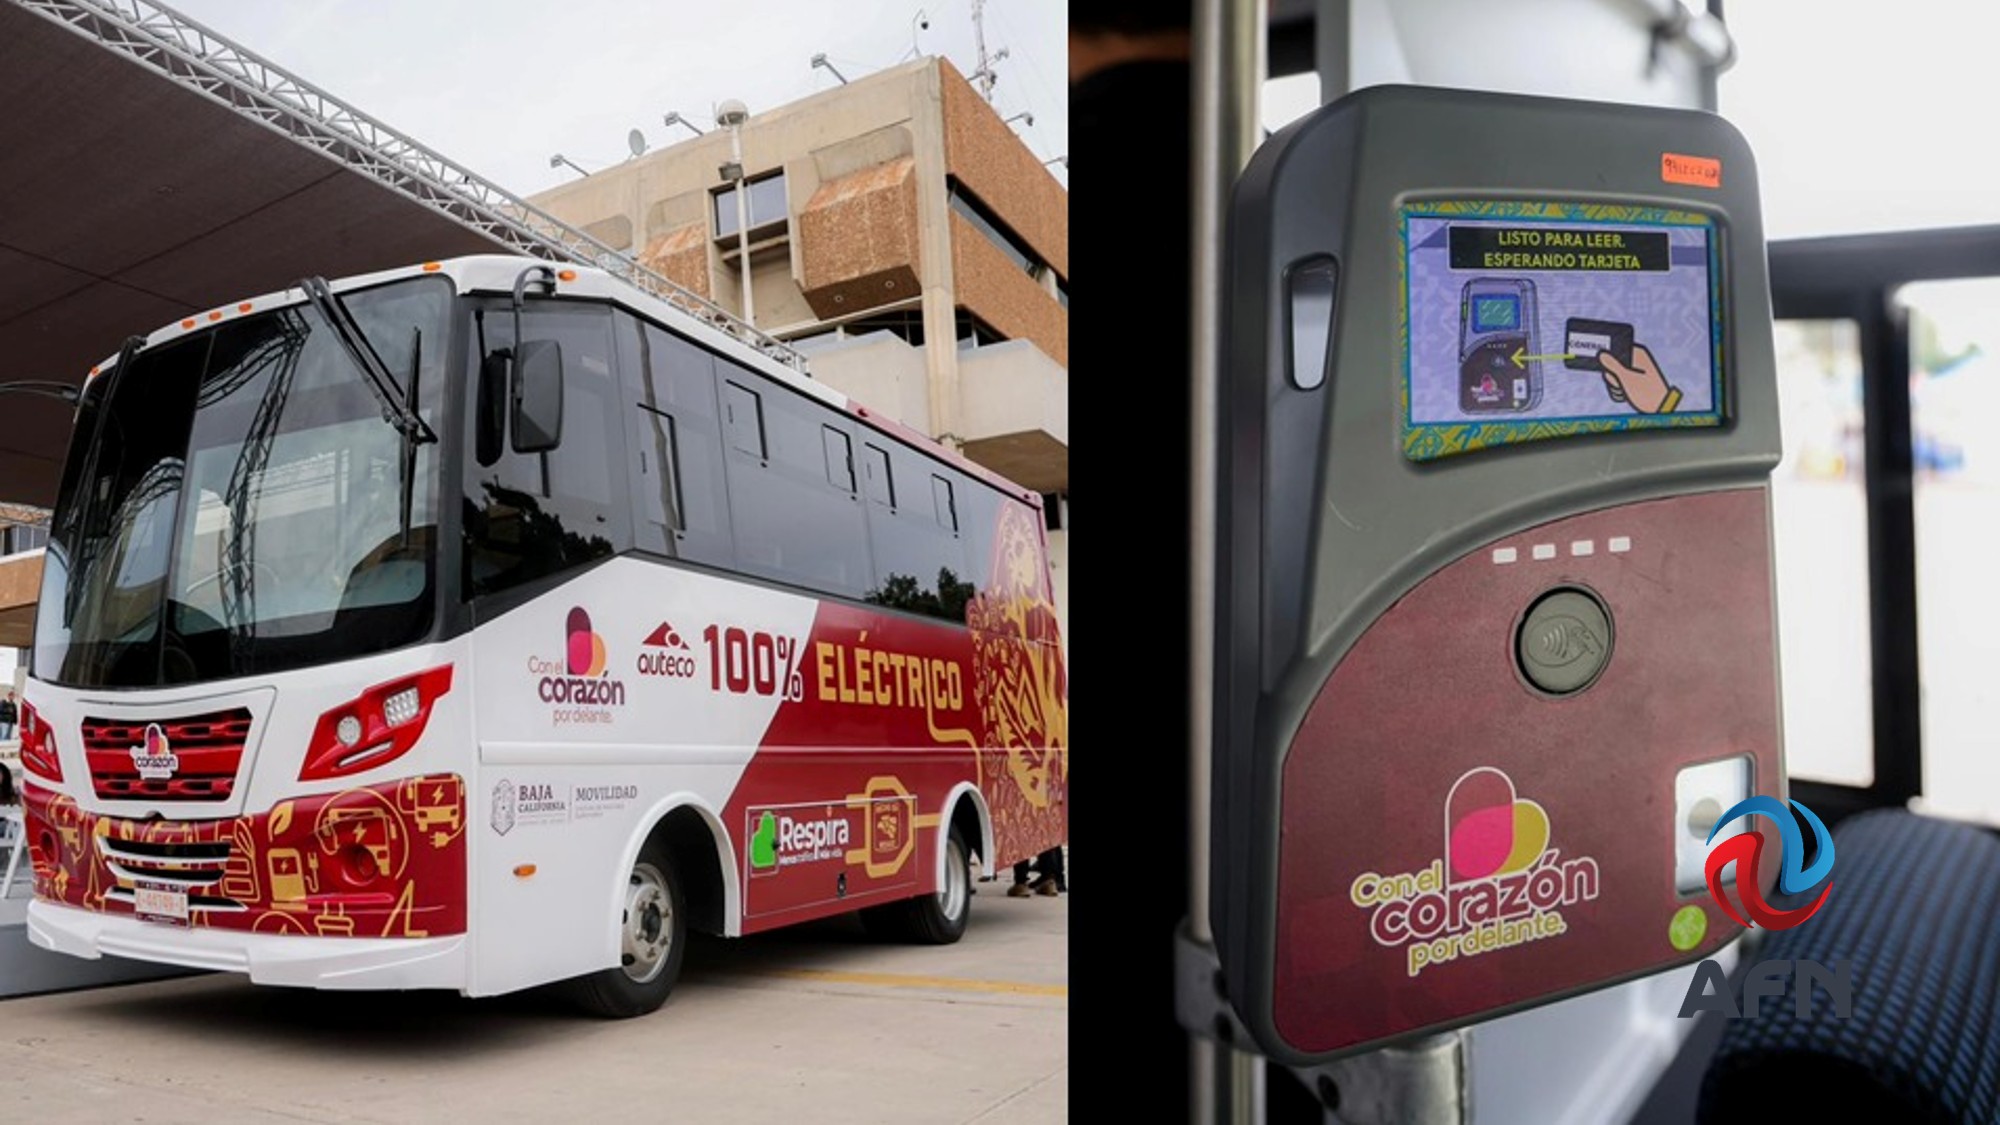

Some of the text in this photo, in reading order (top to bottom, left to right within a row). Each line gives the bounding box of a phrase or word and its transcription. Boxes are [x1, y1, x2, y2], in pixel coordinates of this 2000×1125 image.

[1499, 231, 1626, 248] LISTO PARA LEER.
[1484, 253, 1641, 269] ESPERANDO TARJETA
[528, 655, 564, 674] Con el
[637, 652, 695, 678] auteco
[703, 624, 963, 711] 100% ELÉCTRICO
[538, 670, 625, 705] corazón
[553, 709, 573, 727] por
[518, 784, 638, 801] BAJA MOVILIDAD
[518, 802, 566, 813] CALIFORNIA
[779, 806, 849, 860] Respira
[1352, 860, 1443, 907] Con el
[1371, 849, 1598, 945] corazón
[1408, 911, 1567, 976] por delante.
